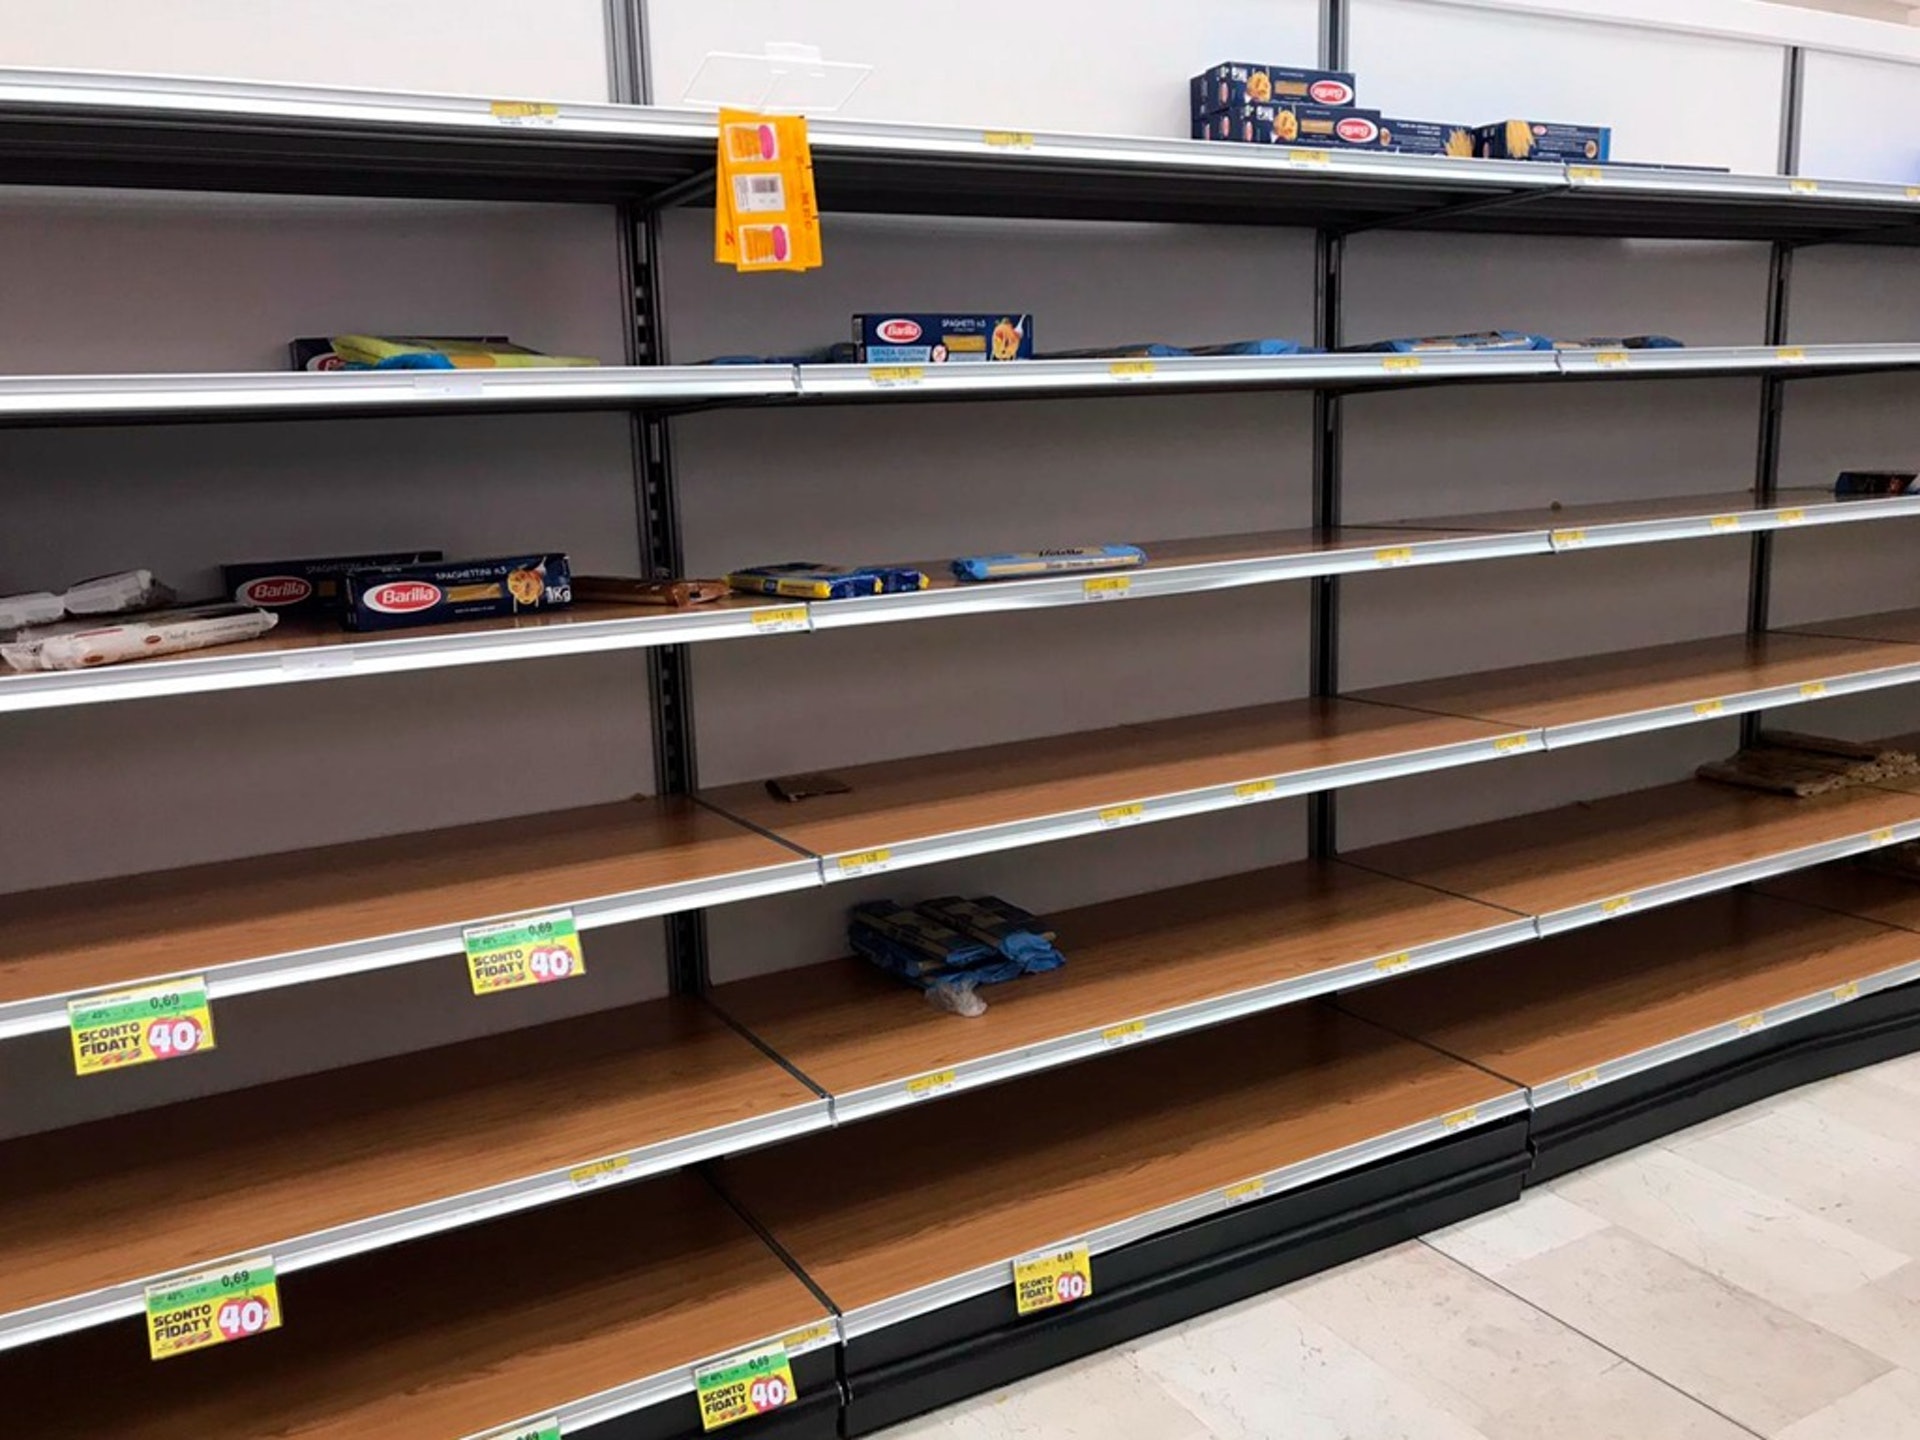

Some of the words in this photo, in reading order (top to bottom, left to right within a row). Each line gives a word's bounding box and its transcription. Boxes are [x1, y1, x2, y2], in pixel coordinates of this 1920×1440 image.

[886, 324, 918, 338] Barilla
[942, 319, 975, 327] SPAGHETTI
[253, 581, 306, 599] Barilla
[381, 586, 436, 605] Barilla
[527, 921, 553, 937] 0,69
[473, 949, 524, 967] SCONTO
[475, 959, 525, 979] FIDATY
[149, 992, 180, 1010] 0,69
[77, 1021, 142, 1044] SCONTO
[80, 1033, 142, 1058] FIDATY
[220, 1269, 250, 1288] 0,69
[1019, 1274, 1054, 1291] SCONTO
[1020, 1283, 1054, 1301] FIDATY
[152, 1303, 212, 1329] SCONTO
[155, 1316, 212, 1341] FIDATY
[702, 1382, 746, 1403] SCONTO
[704, 1392, 747, 1415] FIDATY
